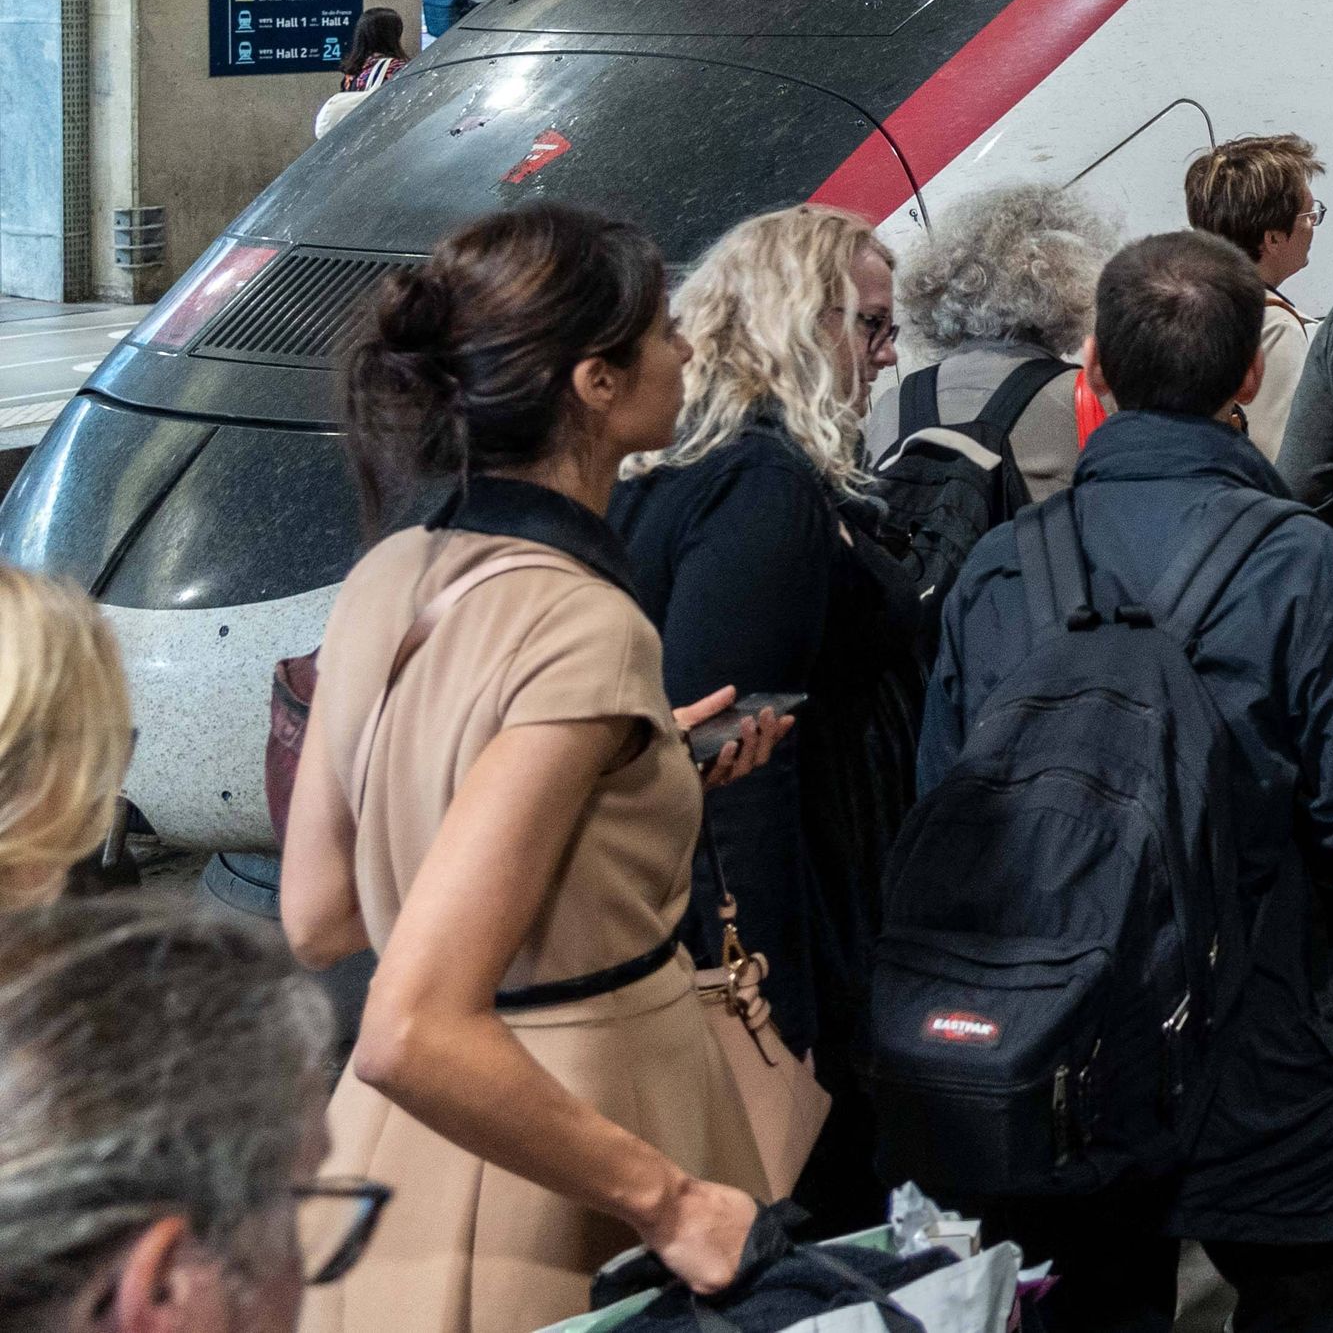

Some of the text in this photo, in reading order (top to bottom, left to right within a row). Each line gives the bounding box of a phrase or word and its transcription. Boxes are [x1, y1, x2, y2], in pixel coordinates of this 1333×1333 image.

[276, 17, 298, 28] Hall
[301, 17, 307, 27] 1
[321, 16, 341, 26] Hall
[342, 16, 349, 25] 4
[276, 48, 298, 59] Hall
[300, 48, 307, 58] 2
[323, 44, 341, 58] 24
[933, 1018, 993, 1035] EASTPAK
